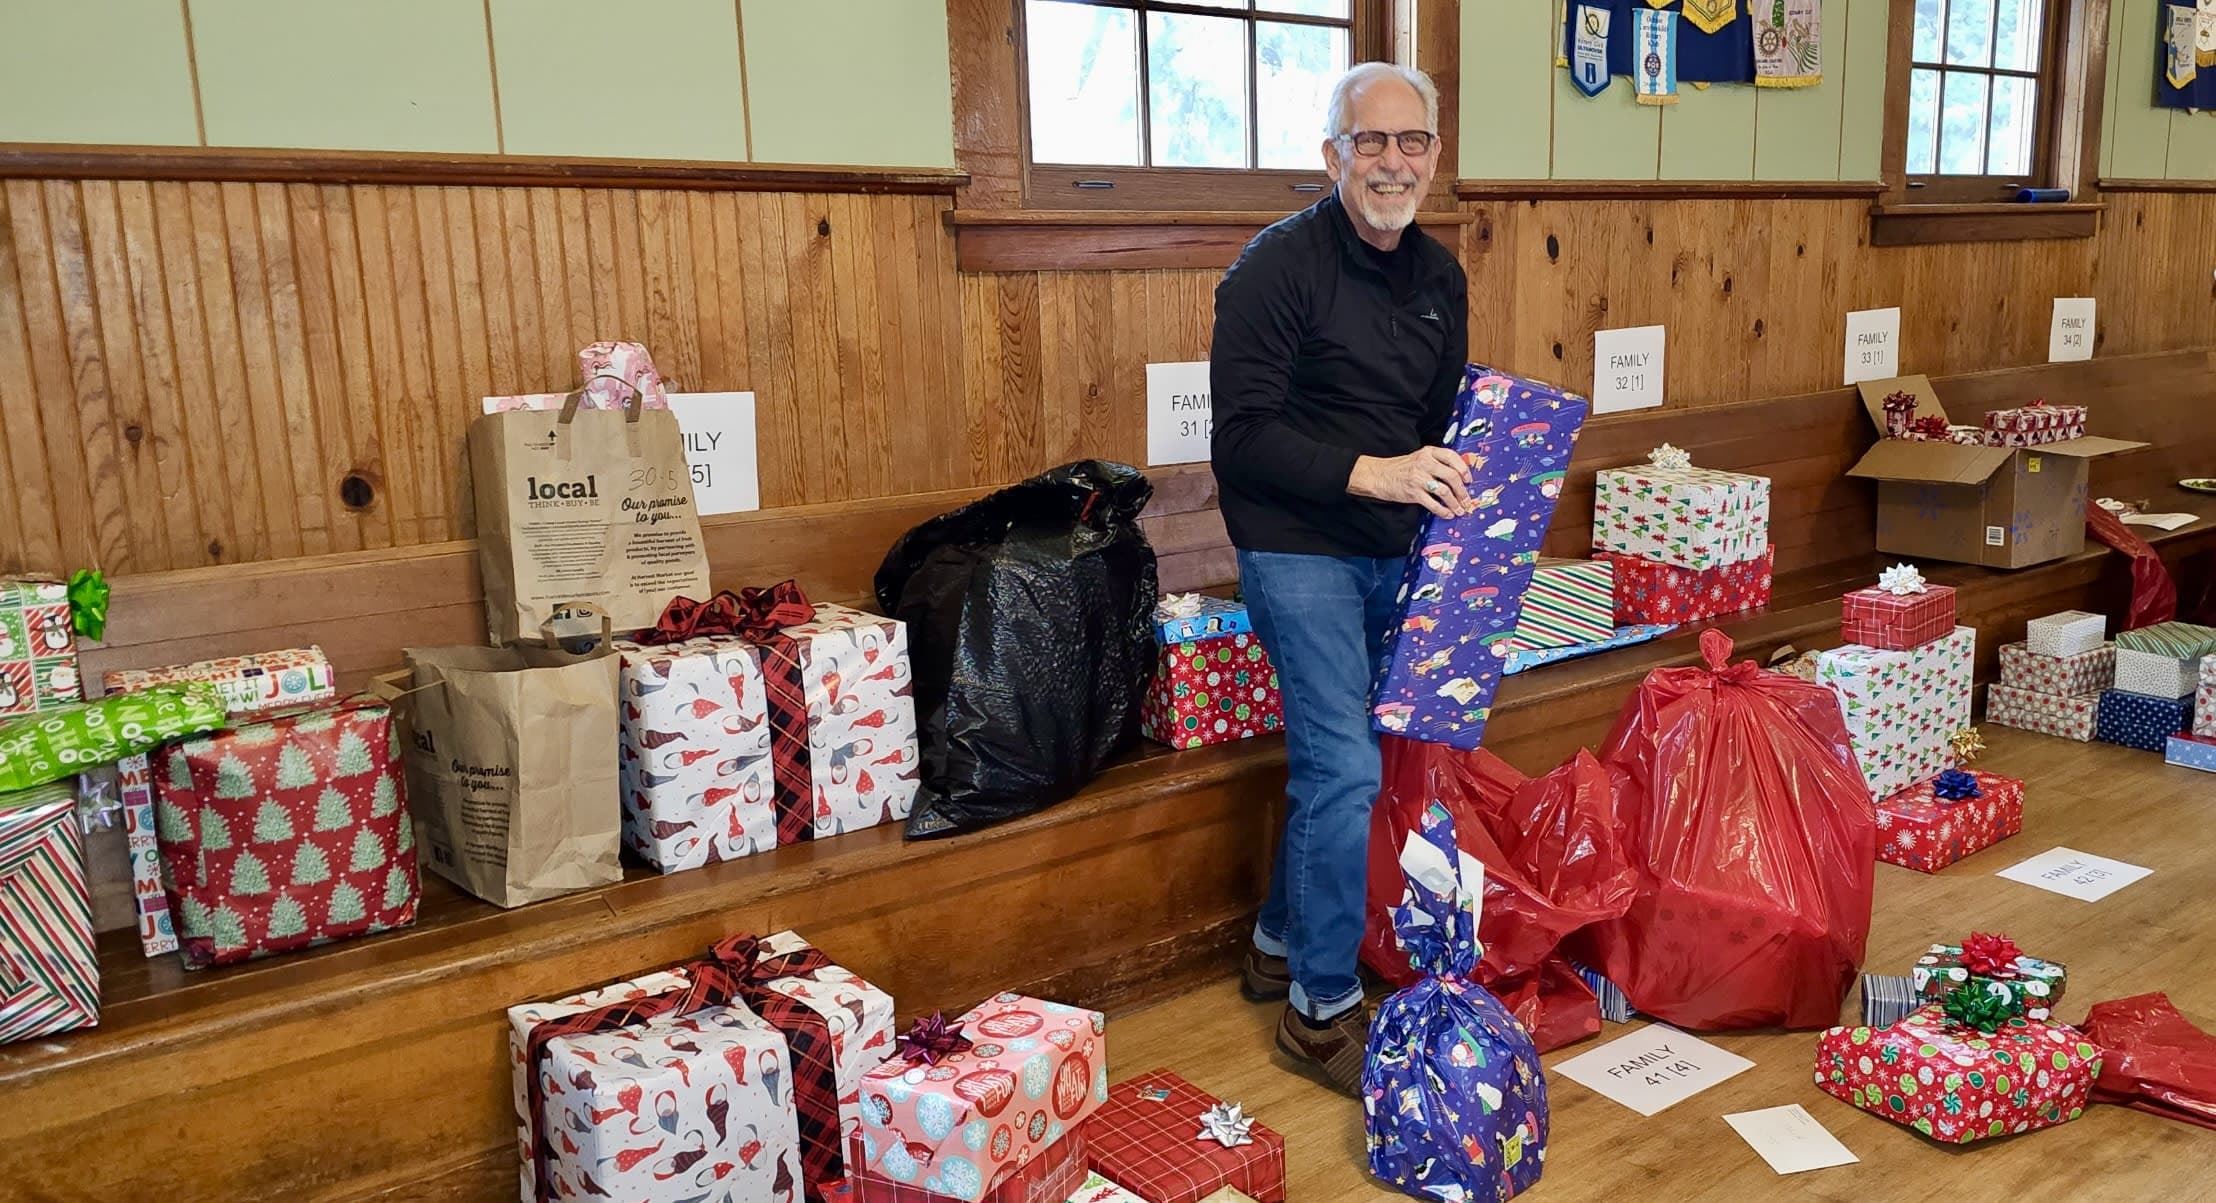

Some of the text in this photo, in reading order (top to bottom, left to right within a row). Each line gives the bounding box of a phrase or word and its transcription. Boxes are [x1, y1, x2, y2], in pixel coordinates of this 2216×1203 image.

[2061, 318, 2086, 330] FAMILY
[1858, 331, 1888, 346] FAMILY
[2063, 334, 2082, 347] 34 [2]
[1610, 352, 1650, 369] FAMILY
[1861, 351, 1884, 365] 33 [1]
[1616, 374, 1644, 391] 32 [1]
[1172, 393, 1210, 412] FAMI
[1180, 419, 1214, 439] 31 [2
[680, 432, 722, 452] ILY
[688, 464, 712, 488] 5]
[528, 475, 598, 500] local
[566, 500, 584, 508] BUY
[622, 495, 688, 512] Our promise
[636, 512, 682, 525] to you...
[452, 759, 512, 778] Our promise
[461, 776, 470, 788] to
[2040, 860, 2087, 880] FAMILY
[1607, 1044, 1676, 1080] FAMILY
[1644, 1060, 1702, 1088] 41 [4]
